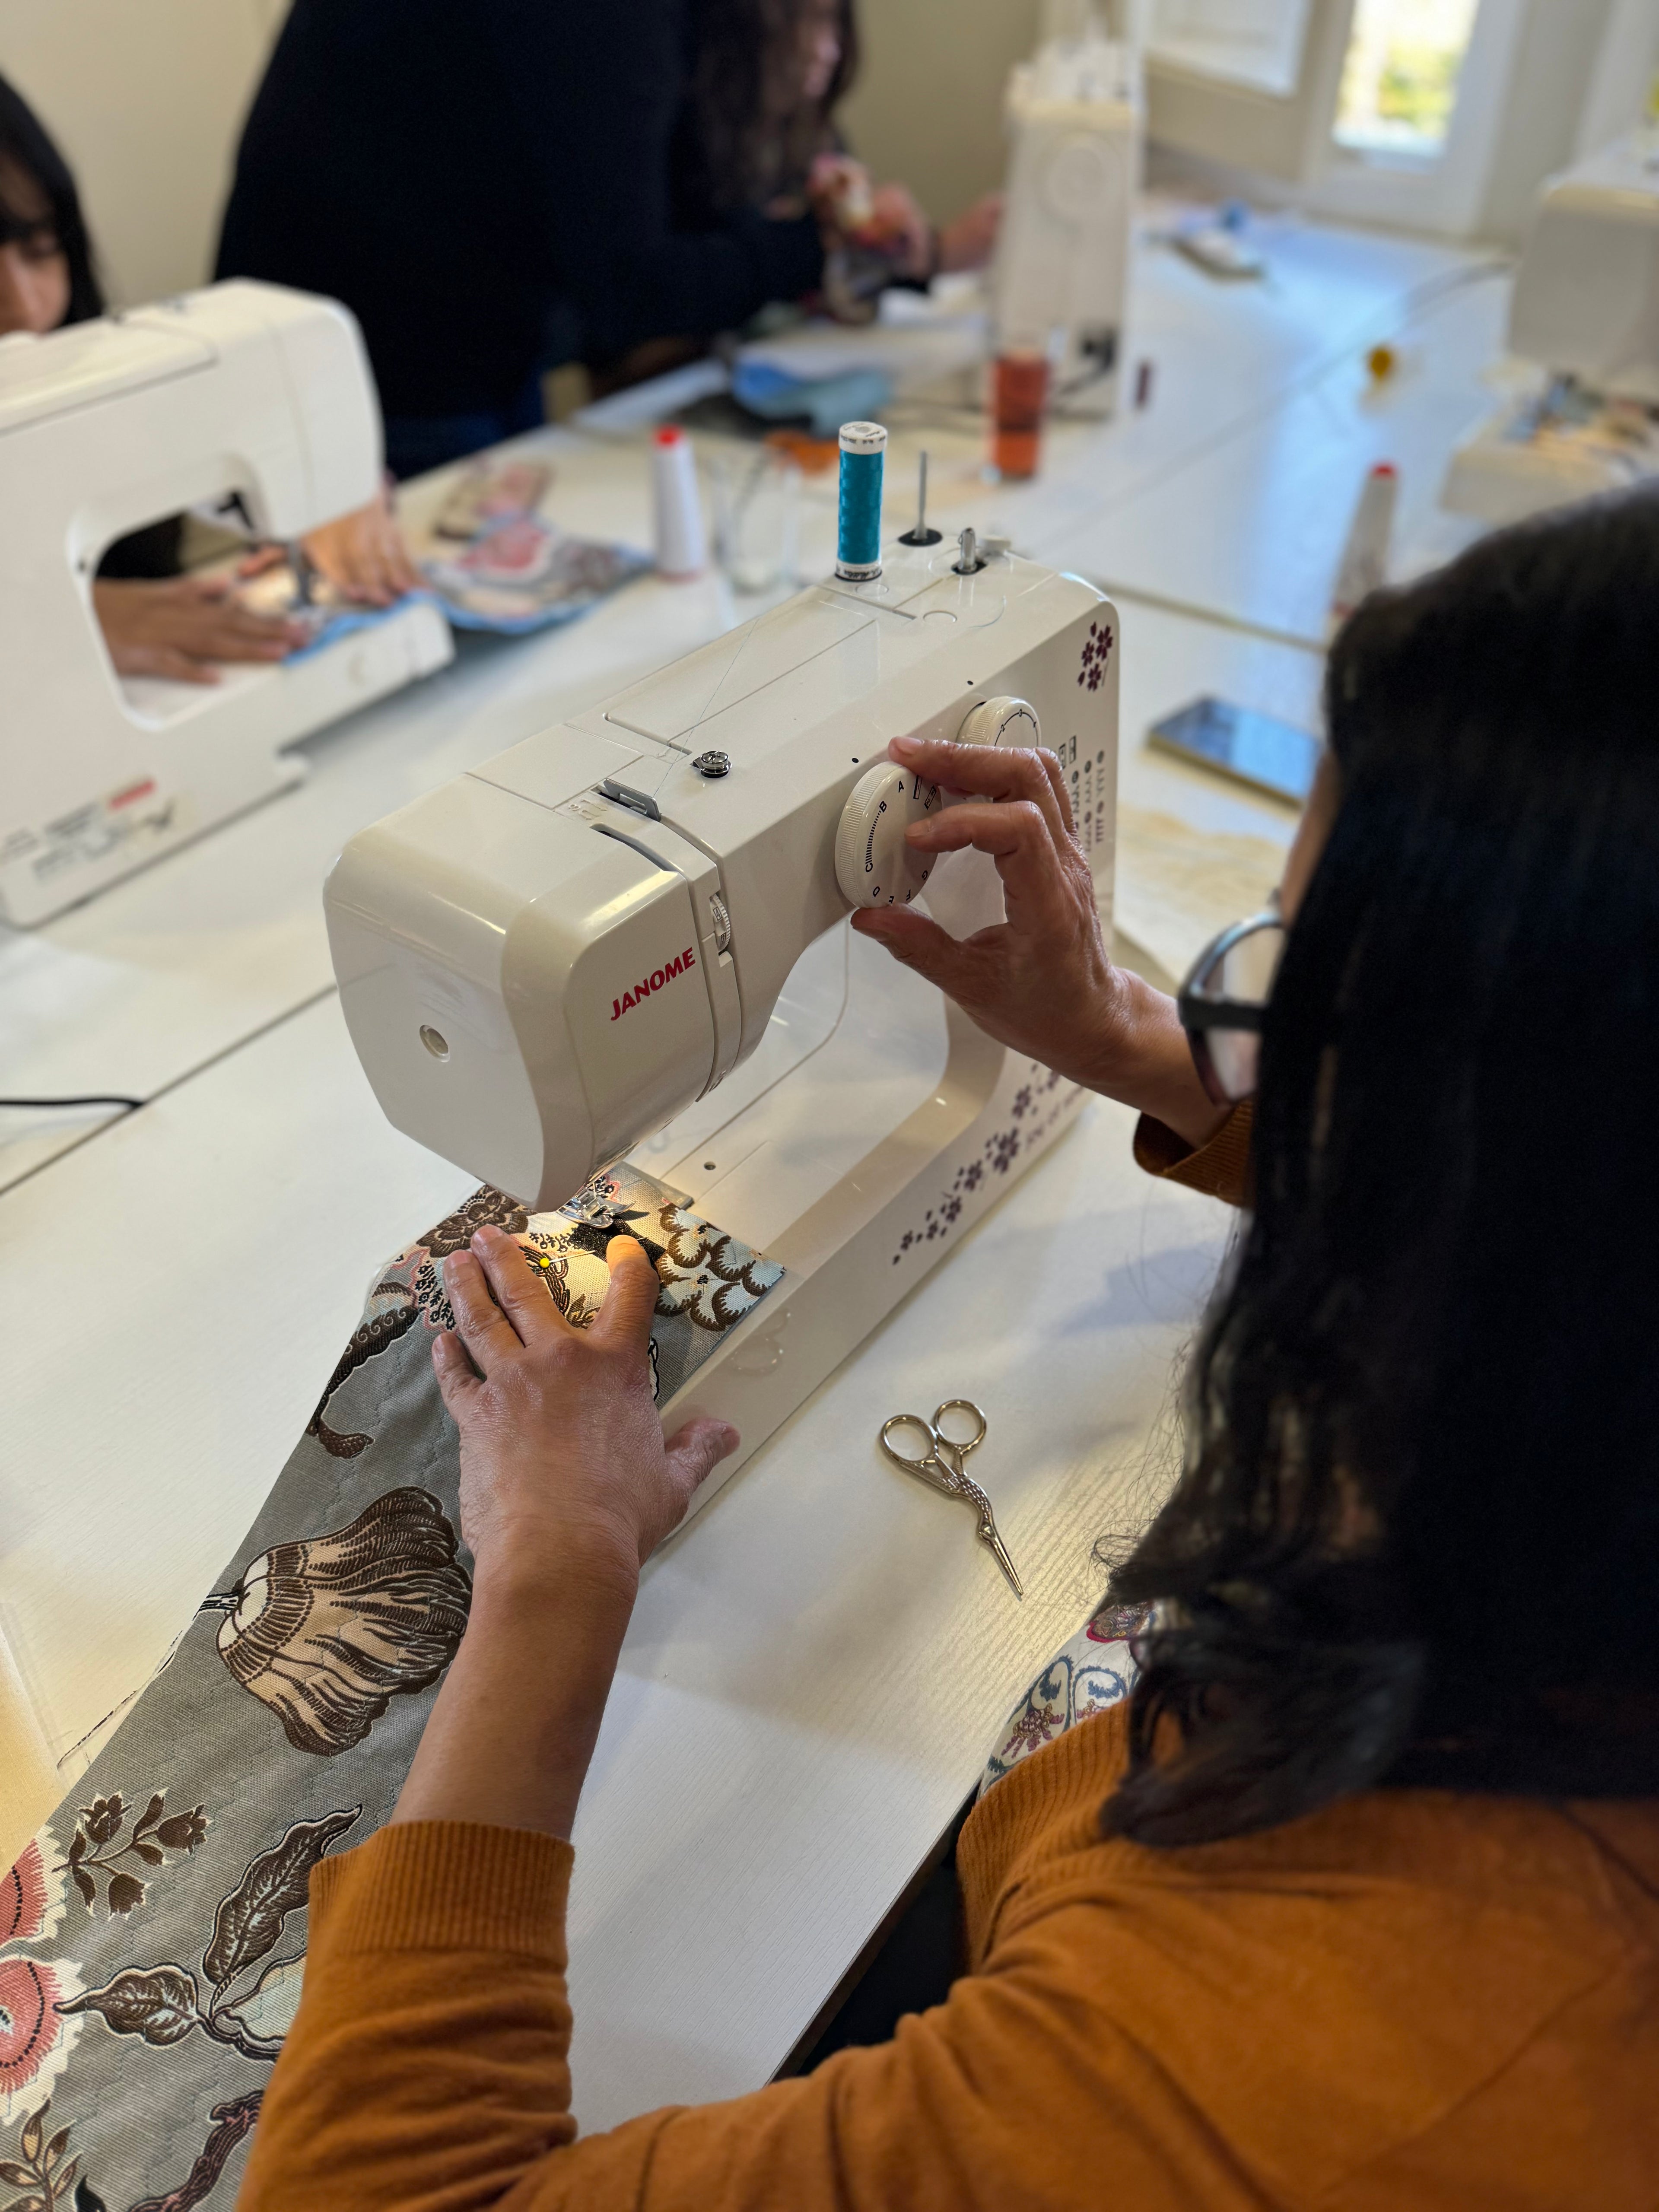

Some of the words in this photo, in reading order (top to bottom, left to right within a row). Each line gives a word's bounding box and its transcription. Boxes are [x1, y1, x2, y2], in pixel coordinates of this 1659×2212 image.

[898, 780, 904, 793] A
[879, 801, 887, 813] B
[865, 862, 873, 873] C
[922, 870, 928, 880] G
[872, 886, 880, 897] D
[906, 889, 911, 901] F
[610, 947, 696, 1021] JANOME
